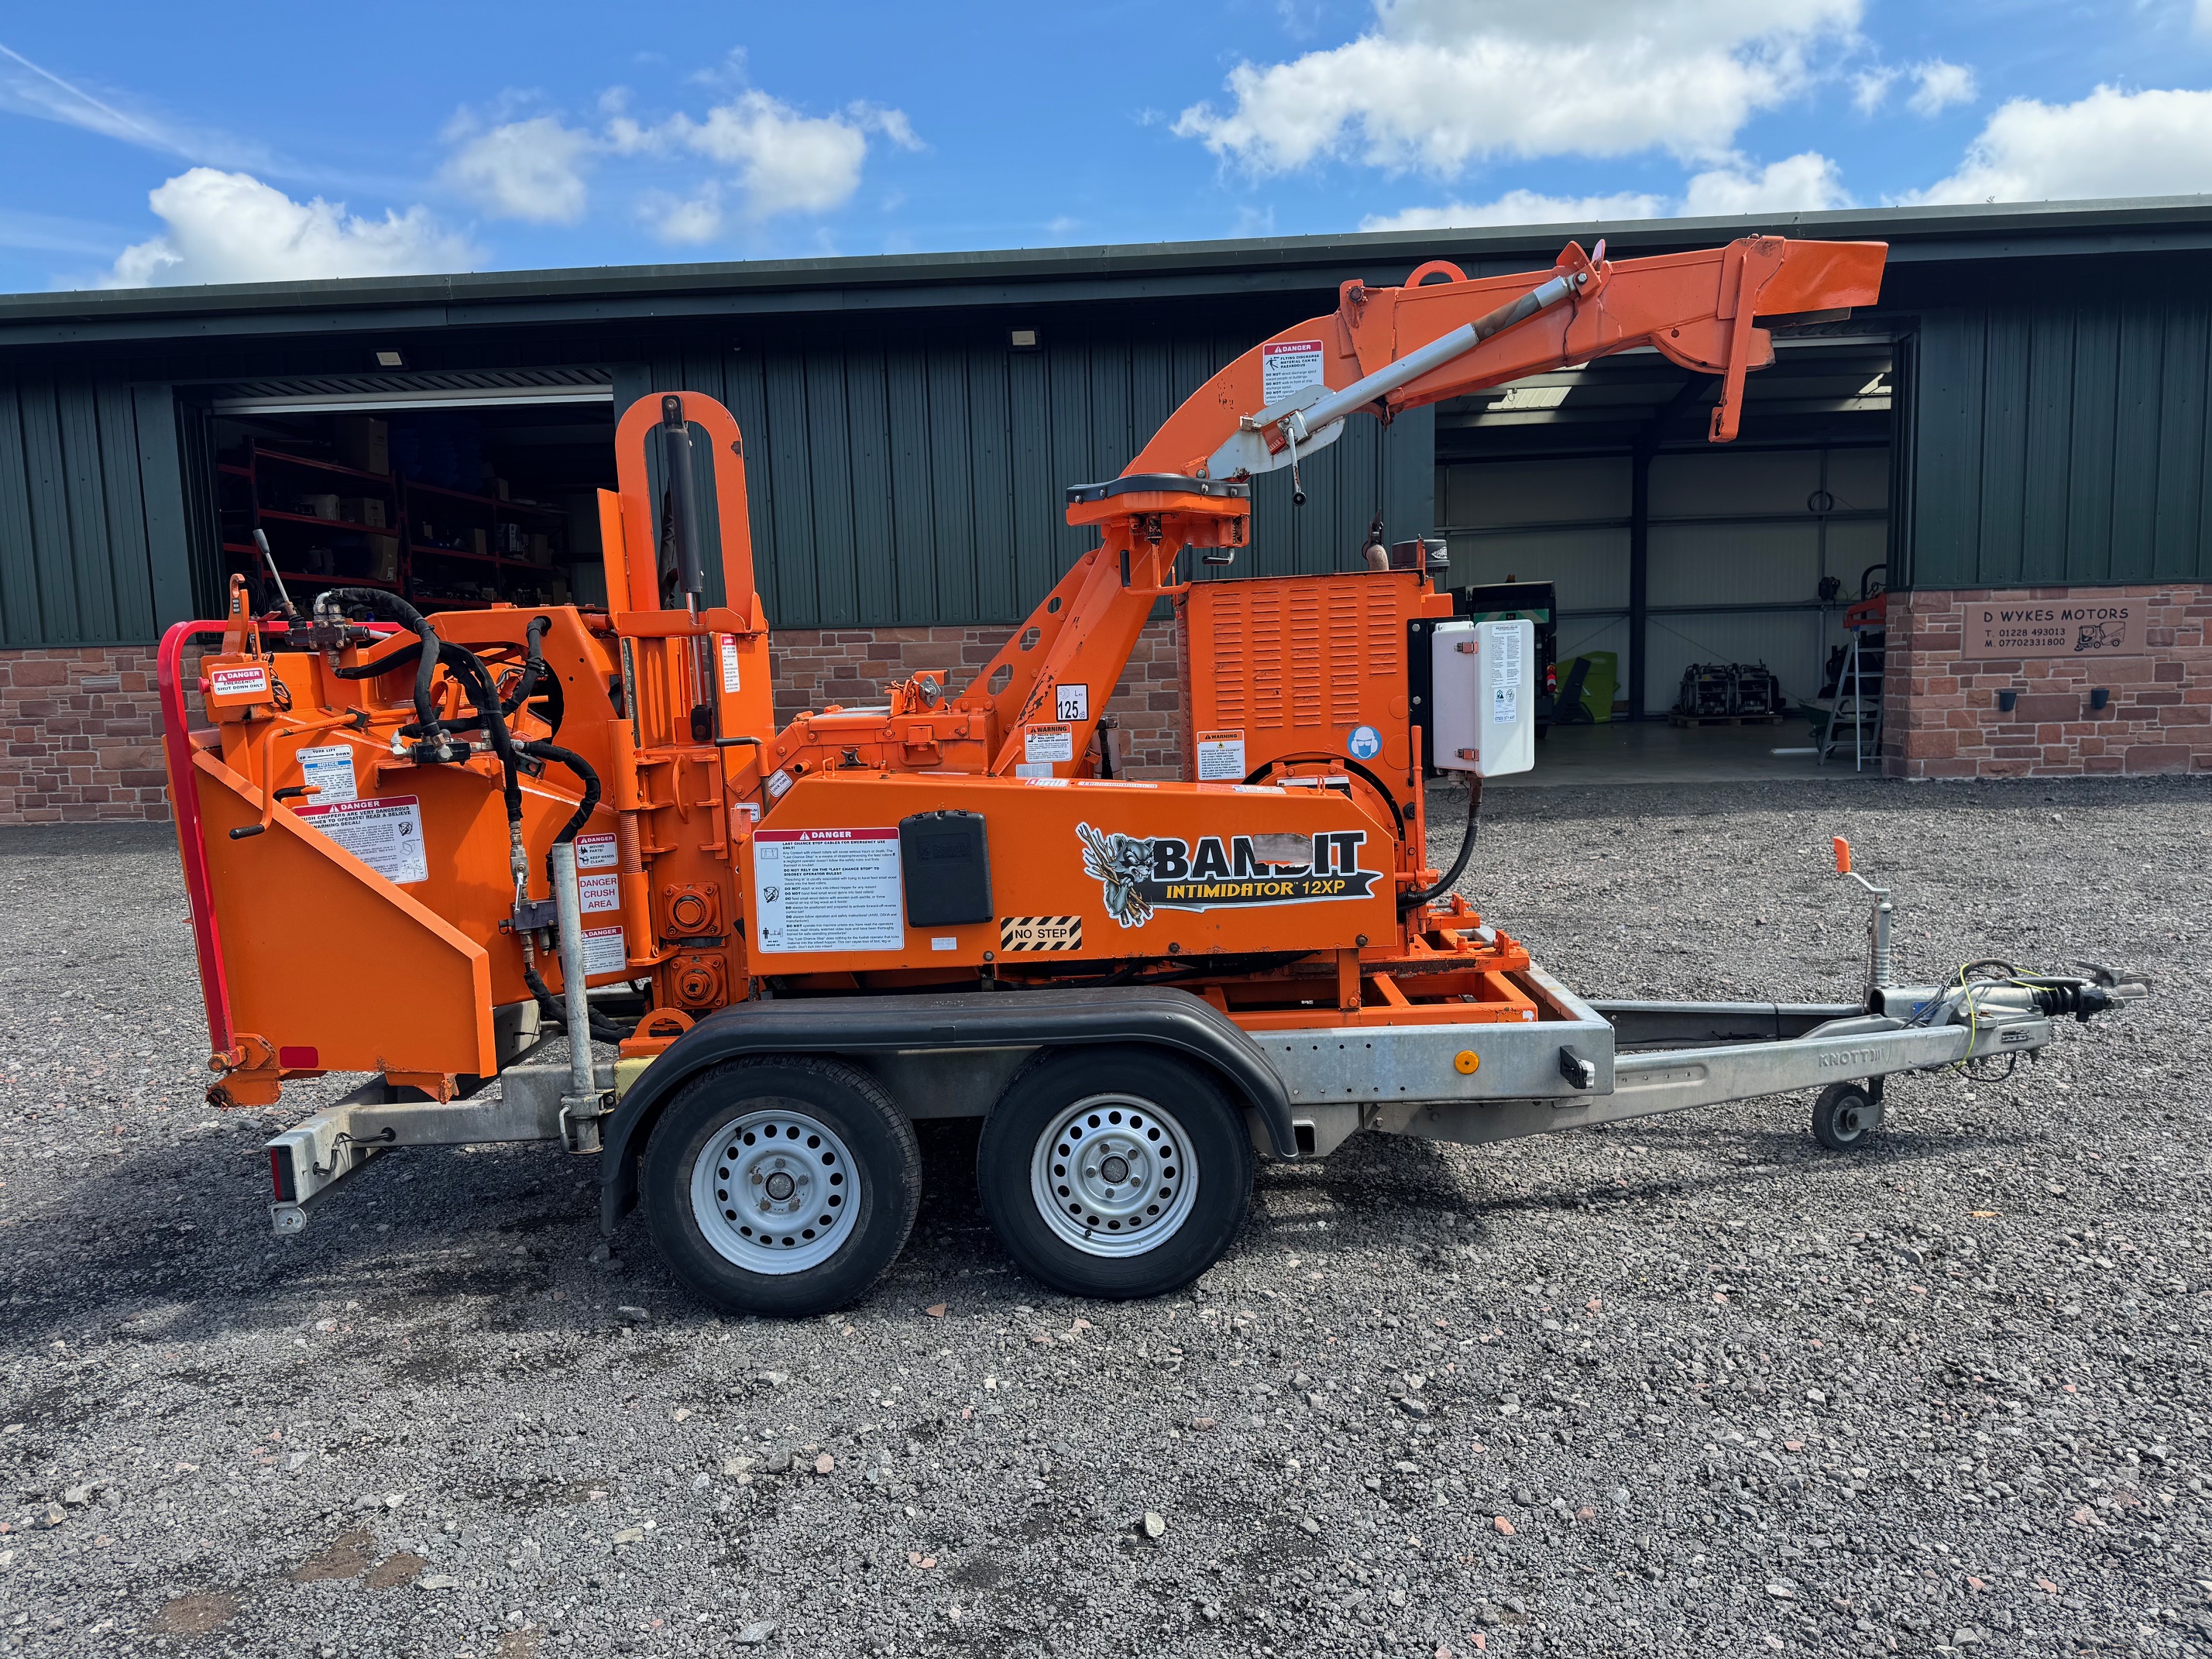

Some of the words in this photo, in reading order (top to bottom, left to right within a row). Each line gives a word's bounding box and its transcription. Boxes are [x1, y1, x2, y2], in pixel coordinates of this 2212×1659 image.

[1984, 612, 1993, 622] D
[2001, 610, 2054, 622] WYKES
[2061, 609, 2128, 620] MOTORS
[1999, 638, 2065, 647] 07702331800
[1059, 701, 1078, 719] 125
[341, 801, 380, 810] DANGER
[1154, 833, 1364, 878] BANIT
[580, 878, 617, 888] DANGER
[1302, 880, 1345, 895] 12XP
[584, 889, 615, 898] CRUSH
[588, 900, 612, 908] AREA
[1015, 929, 1032, 939] NO
[1038, 929, 1067, 938] STEP
[1819, 1049, 1869, 1067] KNOTT
